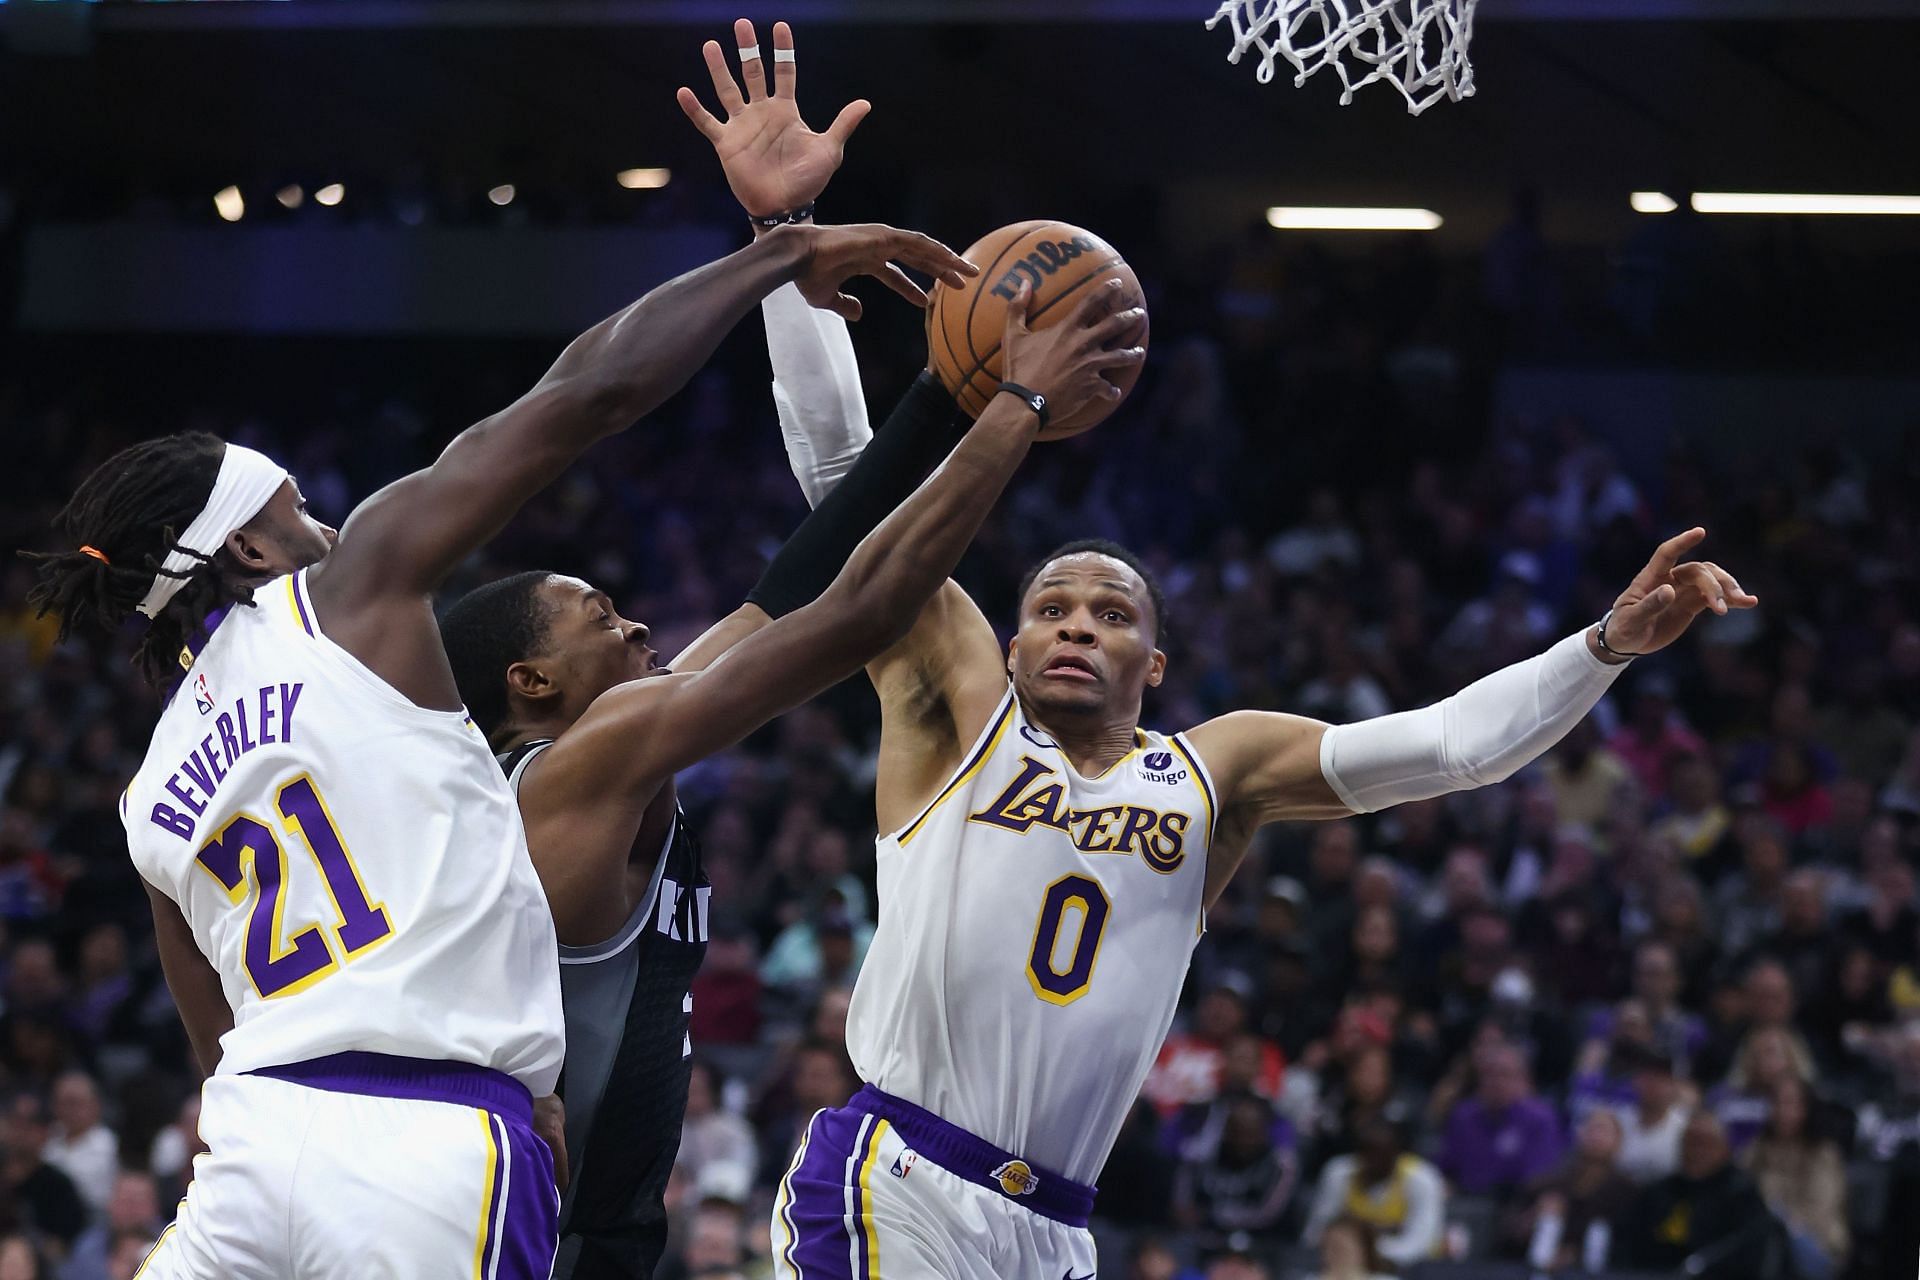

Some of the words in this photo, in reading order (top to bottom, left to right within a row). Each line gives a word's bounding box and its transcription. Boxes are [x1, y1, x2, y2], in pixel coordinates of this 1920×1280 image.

[990, 236, 1096, 301] Wilso
[150, 683, 304, 842] BEVERLEY
[194, 771, 397, 1001] 21
[1025, 872, 1112, 1007] 0
